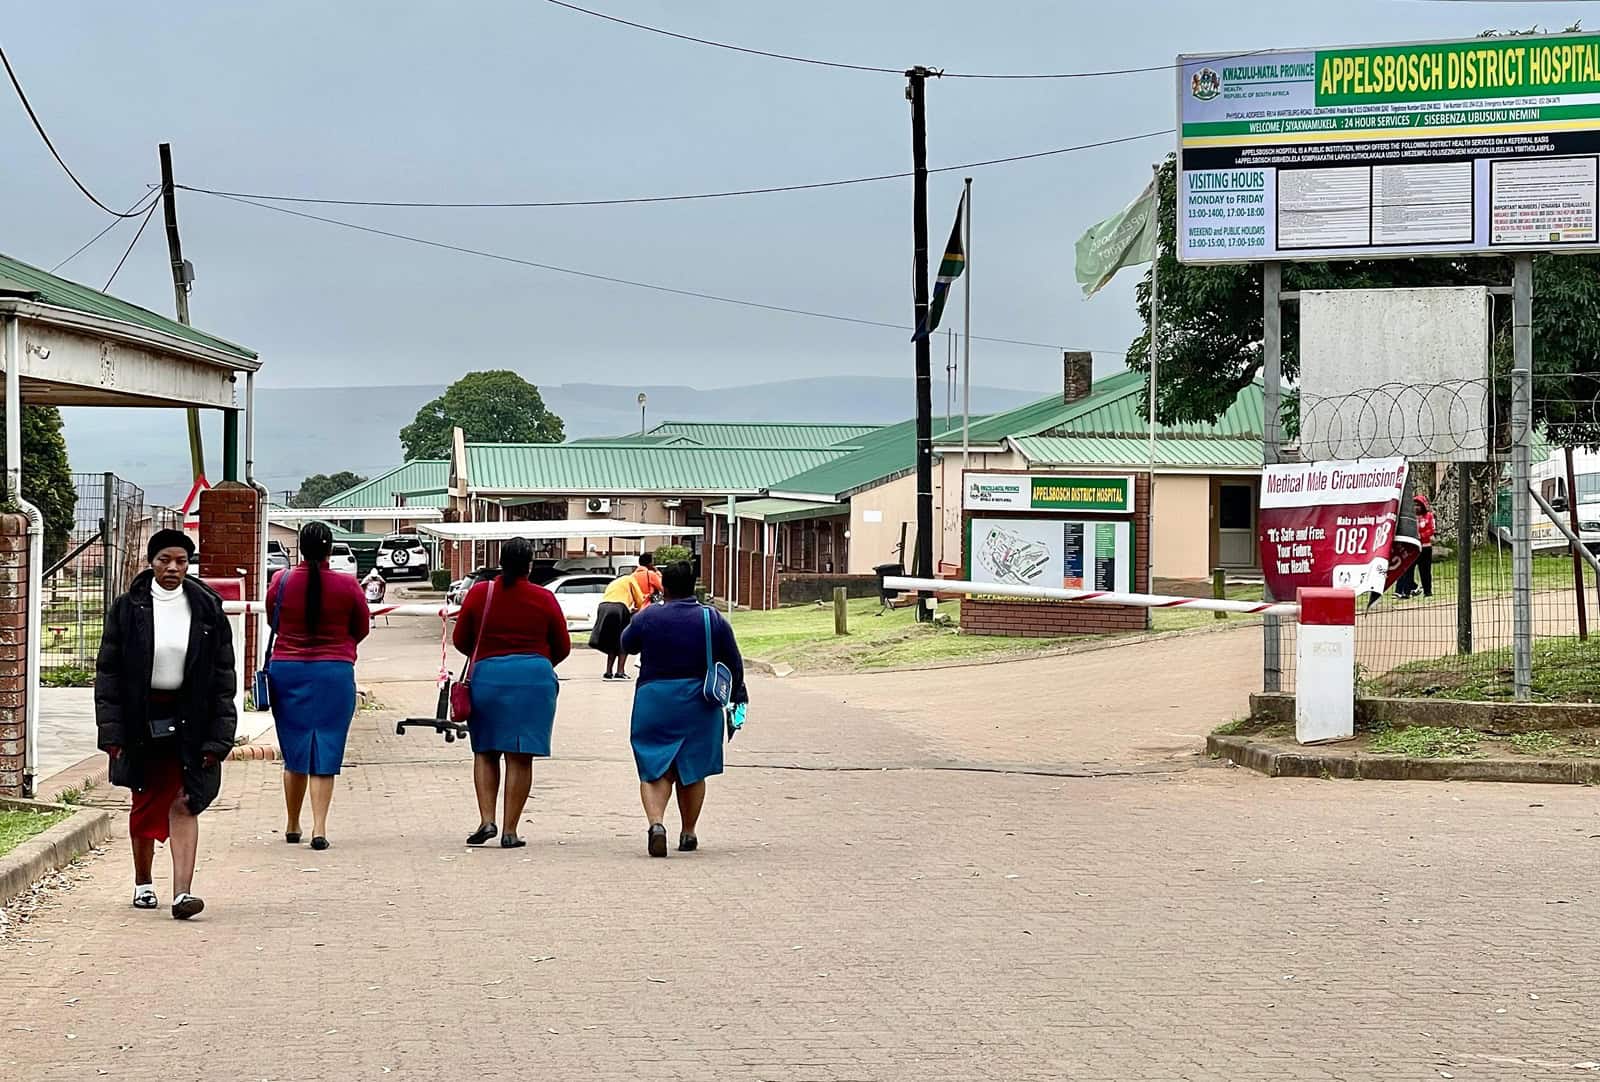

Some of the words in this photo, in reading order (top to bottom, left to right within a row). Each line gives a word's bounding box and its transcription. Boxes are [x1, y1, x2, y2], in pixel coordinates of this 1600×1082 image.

[1223, 65, 1278, 80] KWAZULU-NATAL
[1280, 63, 1314, 78] PROVINCE
[1320, 53, 1443, 95] APPELSBOSCH
[1448, 48, 1525, 89] DISTRICT
[1530, 43, 1600, 85] HOSPITAL
[1250, 120, 1280, 133] WELCOME
[1285, 119, 1337, 132] SIYAKWAMUKELA
[1355, 117, 1377, 128] HOUR
[1378, 115, 1410, 127] SERVICES
[1424, 113, 1466, 125] SISEBENZA
[1468, 111, 1507, 122] UBUSUKU
[1509, 109, 1540, 121] NEMINI
[1275, 146, 1297, 154] HOSPITAL
[1451, 139, 1470, 147] HEALTH
[1471, 138, 1494, 146] SERVICES
[1188, 173, 1229, 189] VISITING
[1231, 171, 1265, 188] HOURS
[1189, 195, 1225, 205] MONDAY
[1227, 195, 1235, 204] to
[1236, 194, 1264, 204] FRIDAY
[1227, 207, 1265, 217] 17:00-18:00
[1189, 227, 1213, 237] WEEKEND
[1213, 227, 1223, 236] and
[1223, 226, 1241, 236] PUBLIC
[1241, 225, 1265, 235] HOLIDAYS
[1228, 237, 1265, 247] 17:00-19:00
[1267, 472, 1304, 493] Medical
[1307, 472, 1328, 492] Male
[1331, 468, 1396, 490] Circumcision
[1033, 486, 1070, 502] APPELSBOSCH
[1071, 487, 1096, 502] DISTRICT
[1096, 487, 1123, 502] HOSPITAL
[1281, 527, 1295, 542] Safe
[1296, 526, 1308, 541] and
[1309, 526, 1326, 541] Free.
[1336, 527, 1367, 555] 082
[1277, 543, 1291, 558] Your
[1276, 560, 1290, 574] Your
